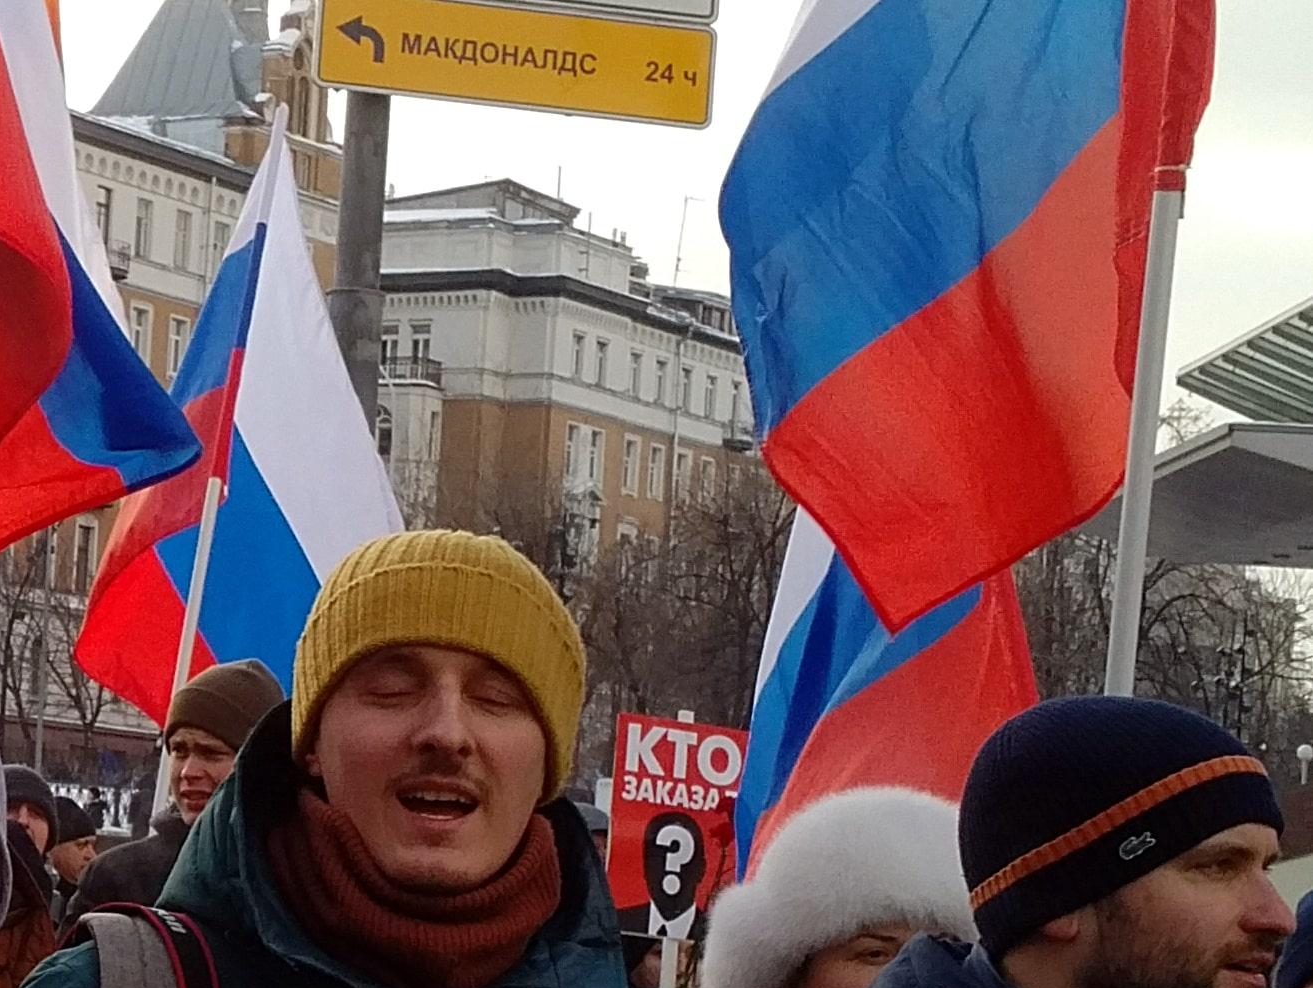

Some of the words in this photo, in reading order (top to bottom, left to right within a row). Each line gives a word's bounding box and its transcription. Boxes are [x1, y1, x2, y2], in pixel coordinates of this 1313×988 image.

[400, 32, 598, 76] МАКДОНАЛДС
[644, 61, 674, 84] 24
[684, 70, 698, 87] ч
[625, 723, 742, 787] КТО
[622, 775, 737, 811] ЗАКАЗА
[655, 824, 695, 896] ?
